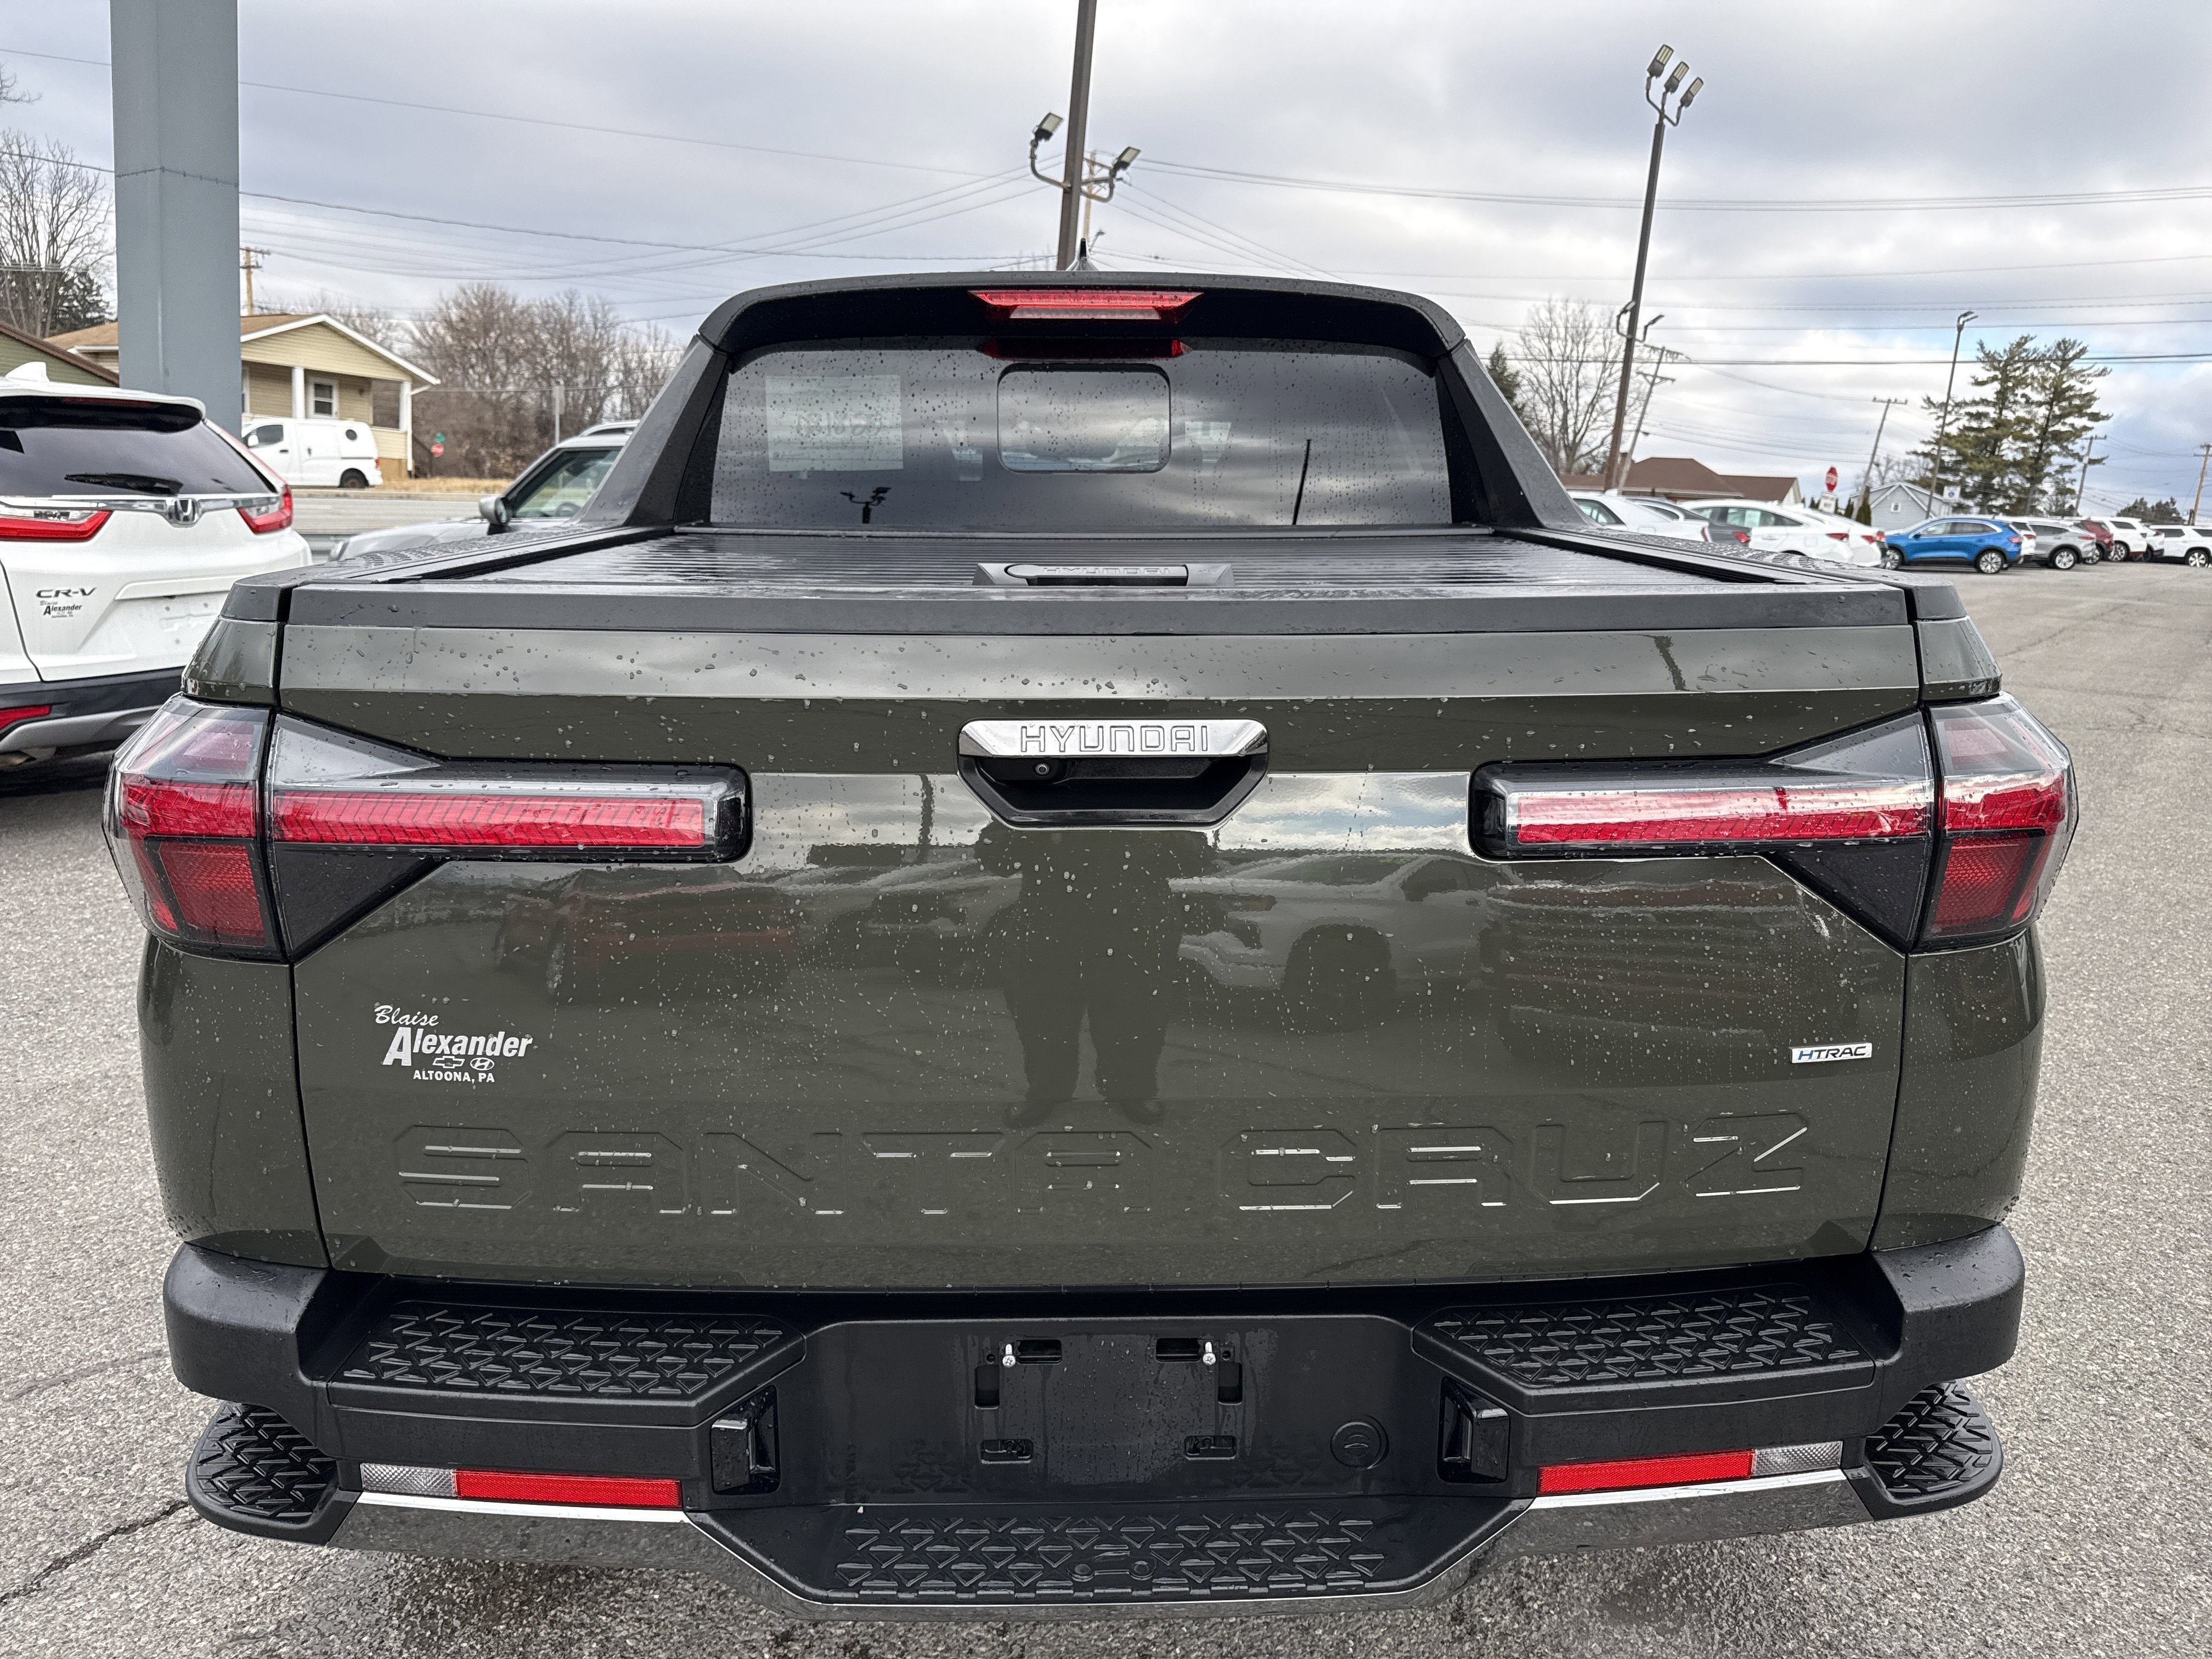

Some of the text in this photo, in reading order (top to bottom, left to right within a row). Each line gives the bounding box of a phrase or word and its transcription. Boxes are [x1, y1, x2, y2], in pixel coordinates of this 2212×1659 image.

[36, 587, 97, 598] CR-V
[43, 604, 82, 616] Alexander
[1021, 725, 1207, 752] HYUNDAI
[374, 1005, 439, 1026] Blaise
[382, 1026, 533, 1066] Alexander
[1798, 1046, 1867, 1060] HTRAC
[413, 1070, 495, 1084] ALTOONA, PA
[392, 1113, 1809, 1215] SANTA CRUZ
